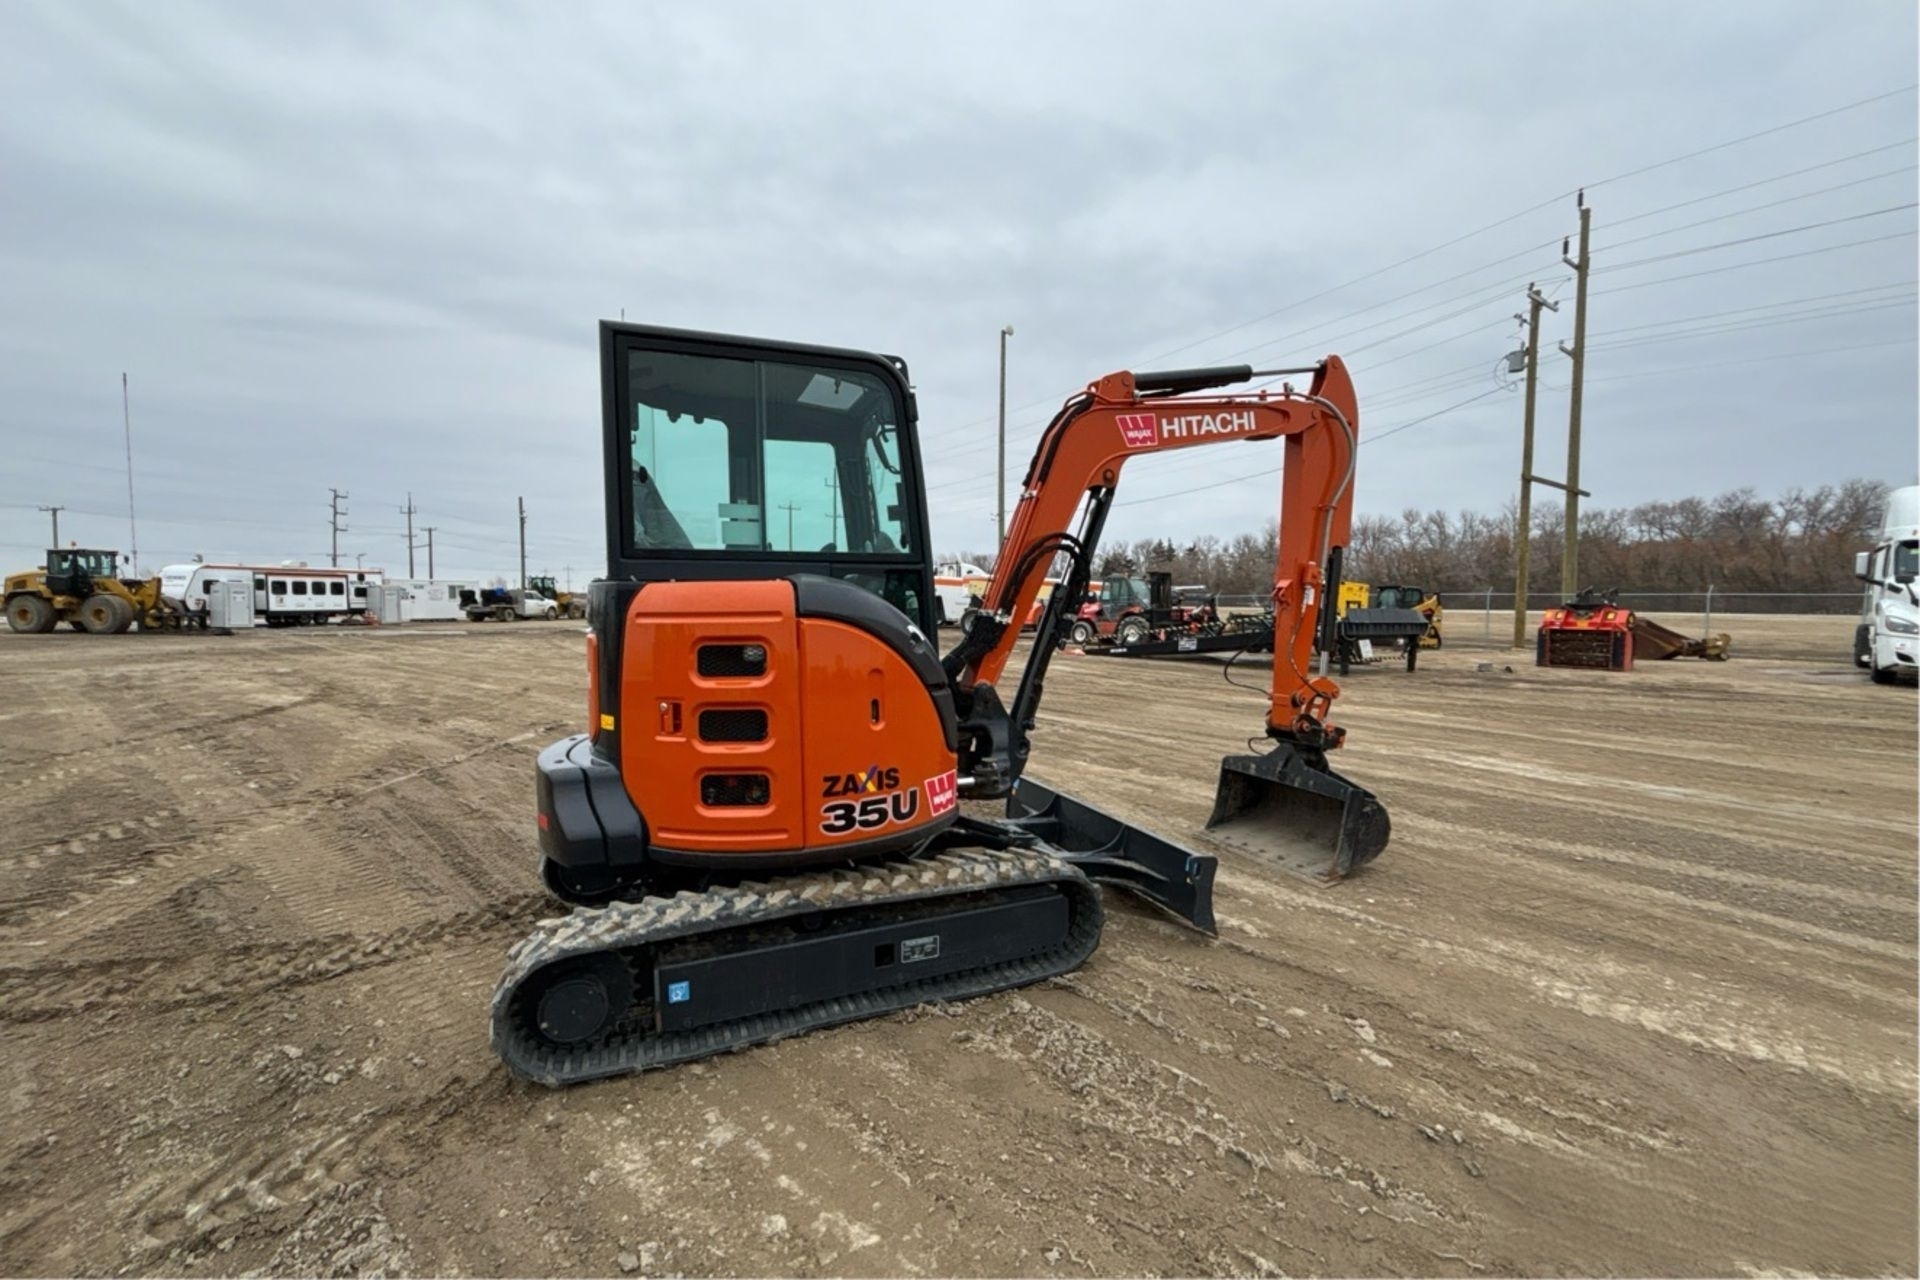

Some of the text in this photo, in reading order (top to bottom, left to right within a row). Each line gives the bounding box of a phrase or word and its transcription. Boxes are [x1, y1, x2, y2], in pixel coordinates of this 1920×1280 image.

[1161, 411, 1256, 438] HITACHI
[822, 765, 900, 798] ZAXIS
[820, 787, 919, 836] 35U
